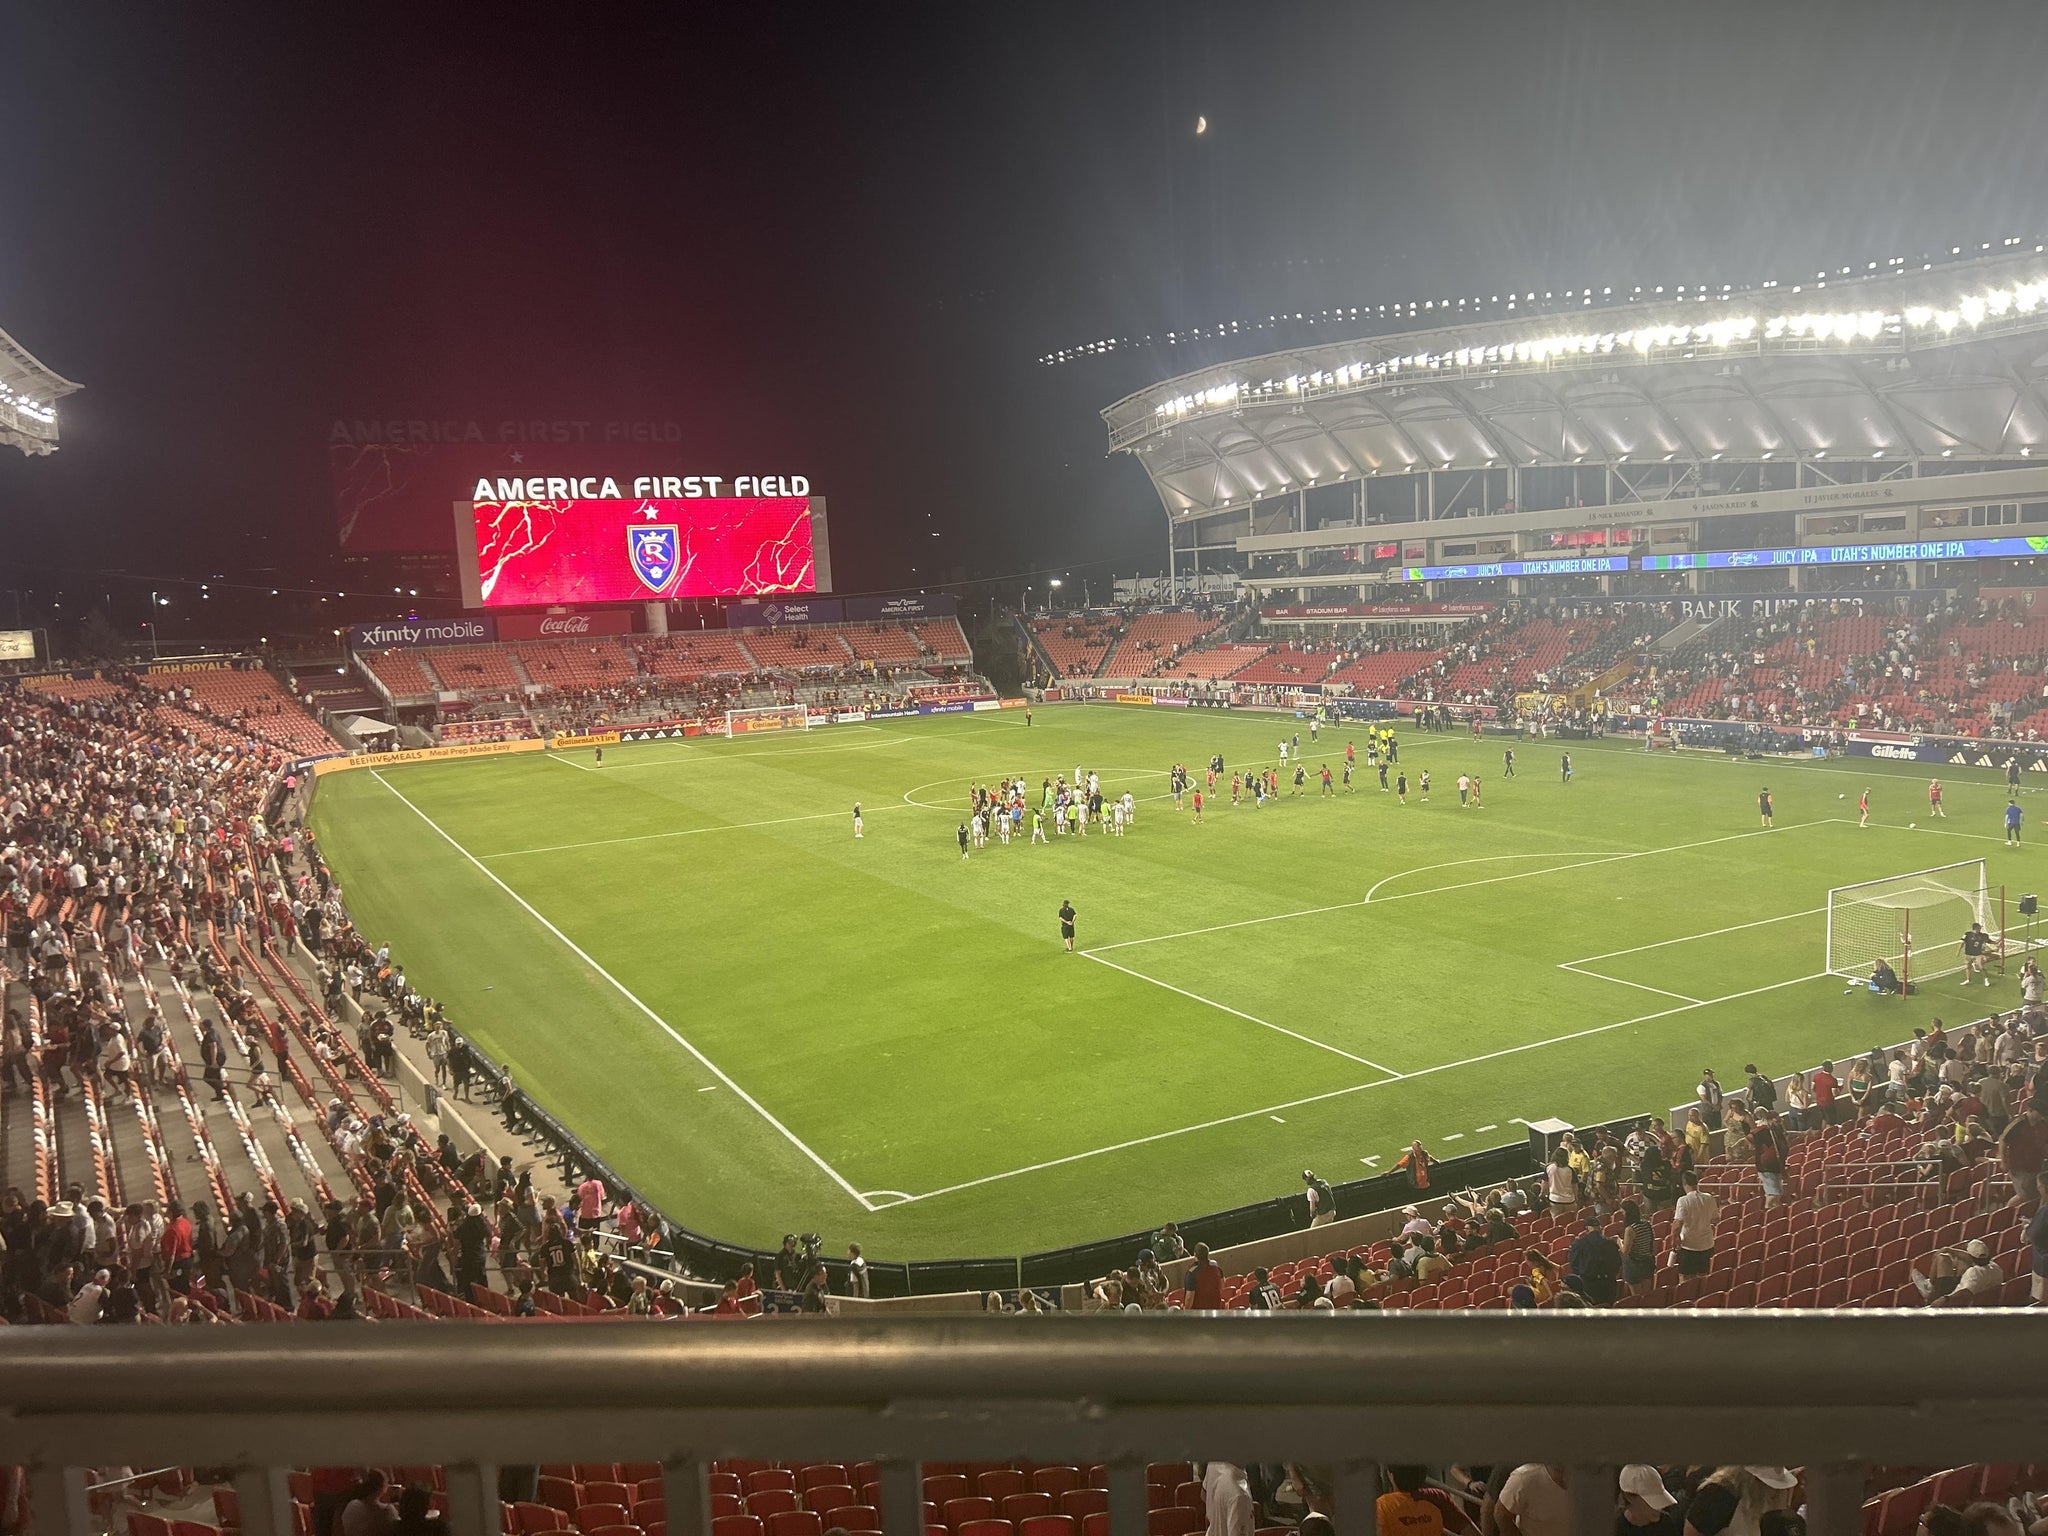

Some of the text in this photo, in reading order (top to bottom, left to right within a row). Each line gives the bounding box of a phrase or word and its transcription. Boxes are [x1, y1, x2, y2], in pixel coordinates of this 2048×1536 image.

[474, 475, 811, 500] AMERICA FIRST FIELD
[1771, 550, 1797, 563] JUICY
[1801, 549, 1818, 563] IPA
[1831, 546, 1868, 561] UTAH'S
[1871, 544, 1918, 560] NUMBER
[1921, 543, 1944, 557] ONE
[1946, 542, 1966, 557] IPA
[1476, 564, 1495, 577] JUICY
[1522, 561, 1548, 574] UTAH'S
[1549, 560, 1580, 573] NUMBER
[1581, 559, 1597, 571] ONE
[1598, 558, 1611, 570] IPA
[784, 605, 809, 613] Select
[784, 613, 809, 621] Health
[1306, 607, 1334, 615] STADIUM
[1680, 599, 1742, 619] BANK
[362, 621, 485, 646] xfinity mobile
[539, 615, 593, 635] Coca-Cola
[148, 661, 233, 675] UTAH ROYALS
[871, 711, 903, 719] Intermountain
[557, 736, 595, 746] Continental
[350, 755, 389, 766] BEEHIVE
[392, 751, 423, 761] MEALS
[429, 749, 450, 757] Meal
[450, 748, 468, 756] Prep
[470, 746, 492, 754] Made
[493, 744, 511, 752] Easy
[1871, 744, 1917, 760] Gillette
[550, 1250, 565, 1267] 10
[1261, 1289, 1281, 1309] 18
